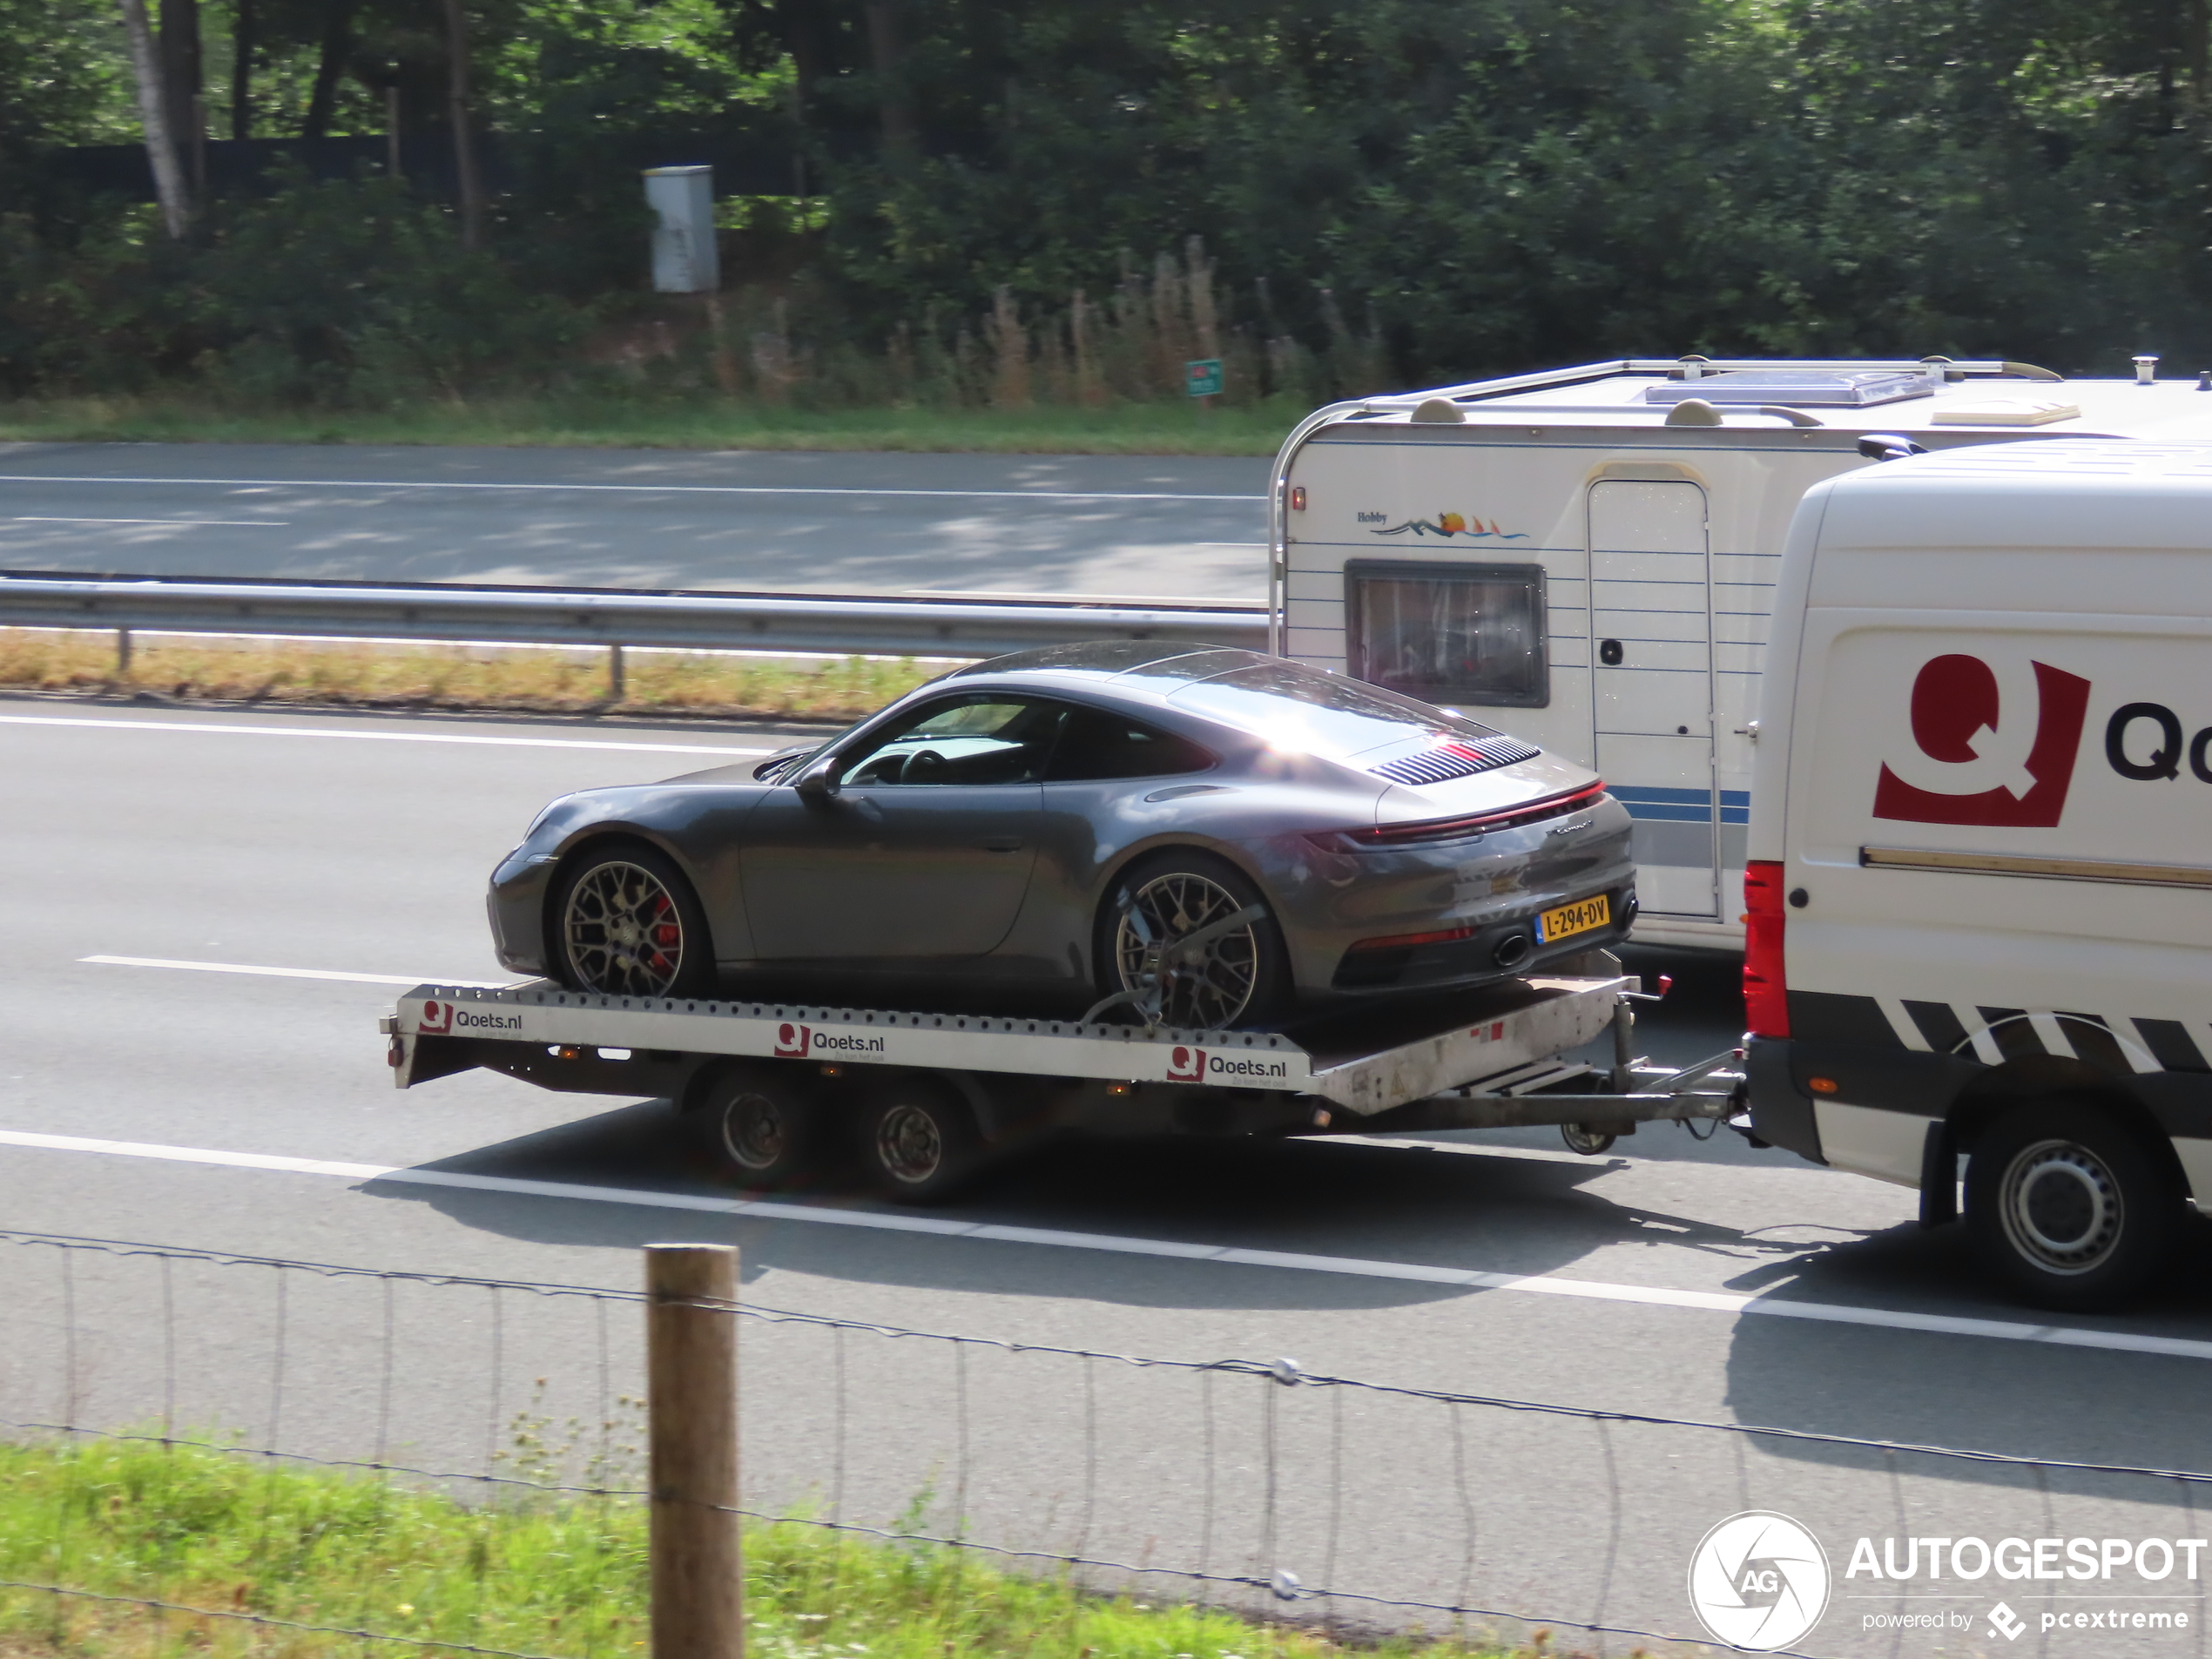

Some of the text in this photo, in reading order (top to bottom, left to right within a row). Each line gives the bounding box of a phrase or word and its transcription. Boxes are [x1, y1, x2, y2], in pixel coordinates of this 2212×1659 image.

[1358, 512, 1387, 524] Hobby
[1547, 900, 1604, 936] L-294-DV
[457, 1011, 522, 1029] Qoets.nl
[813, 1033, 884, 1051] Qoets.nl
[1210, 1057, 1286, 1077] Qoets.nl
